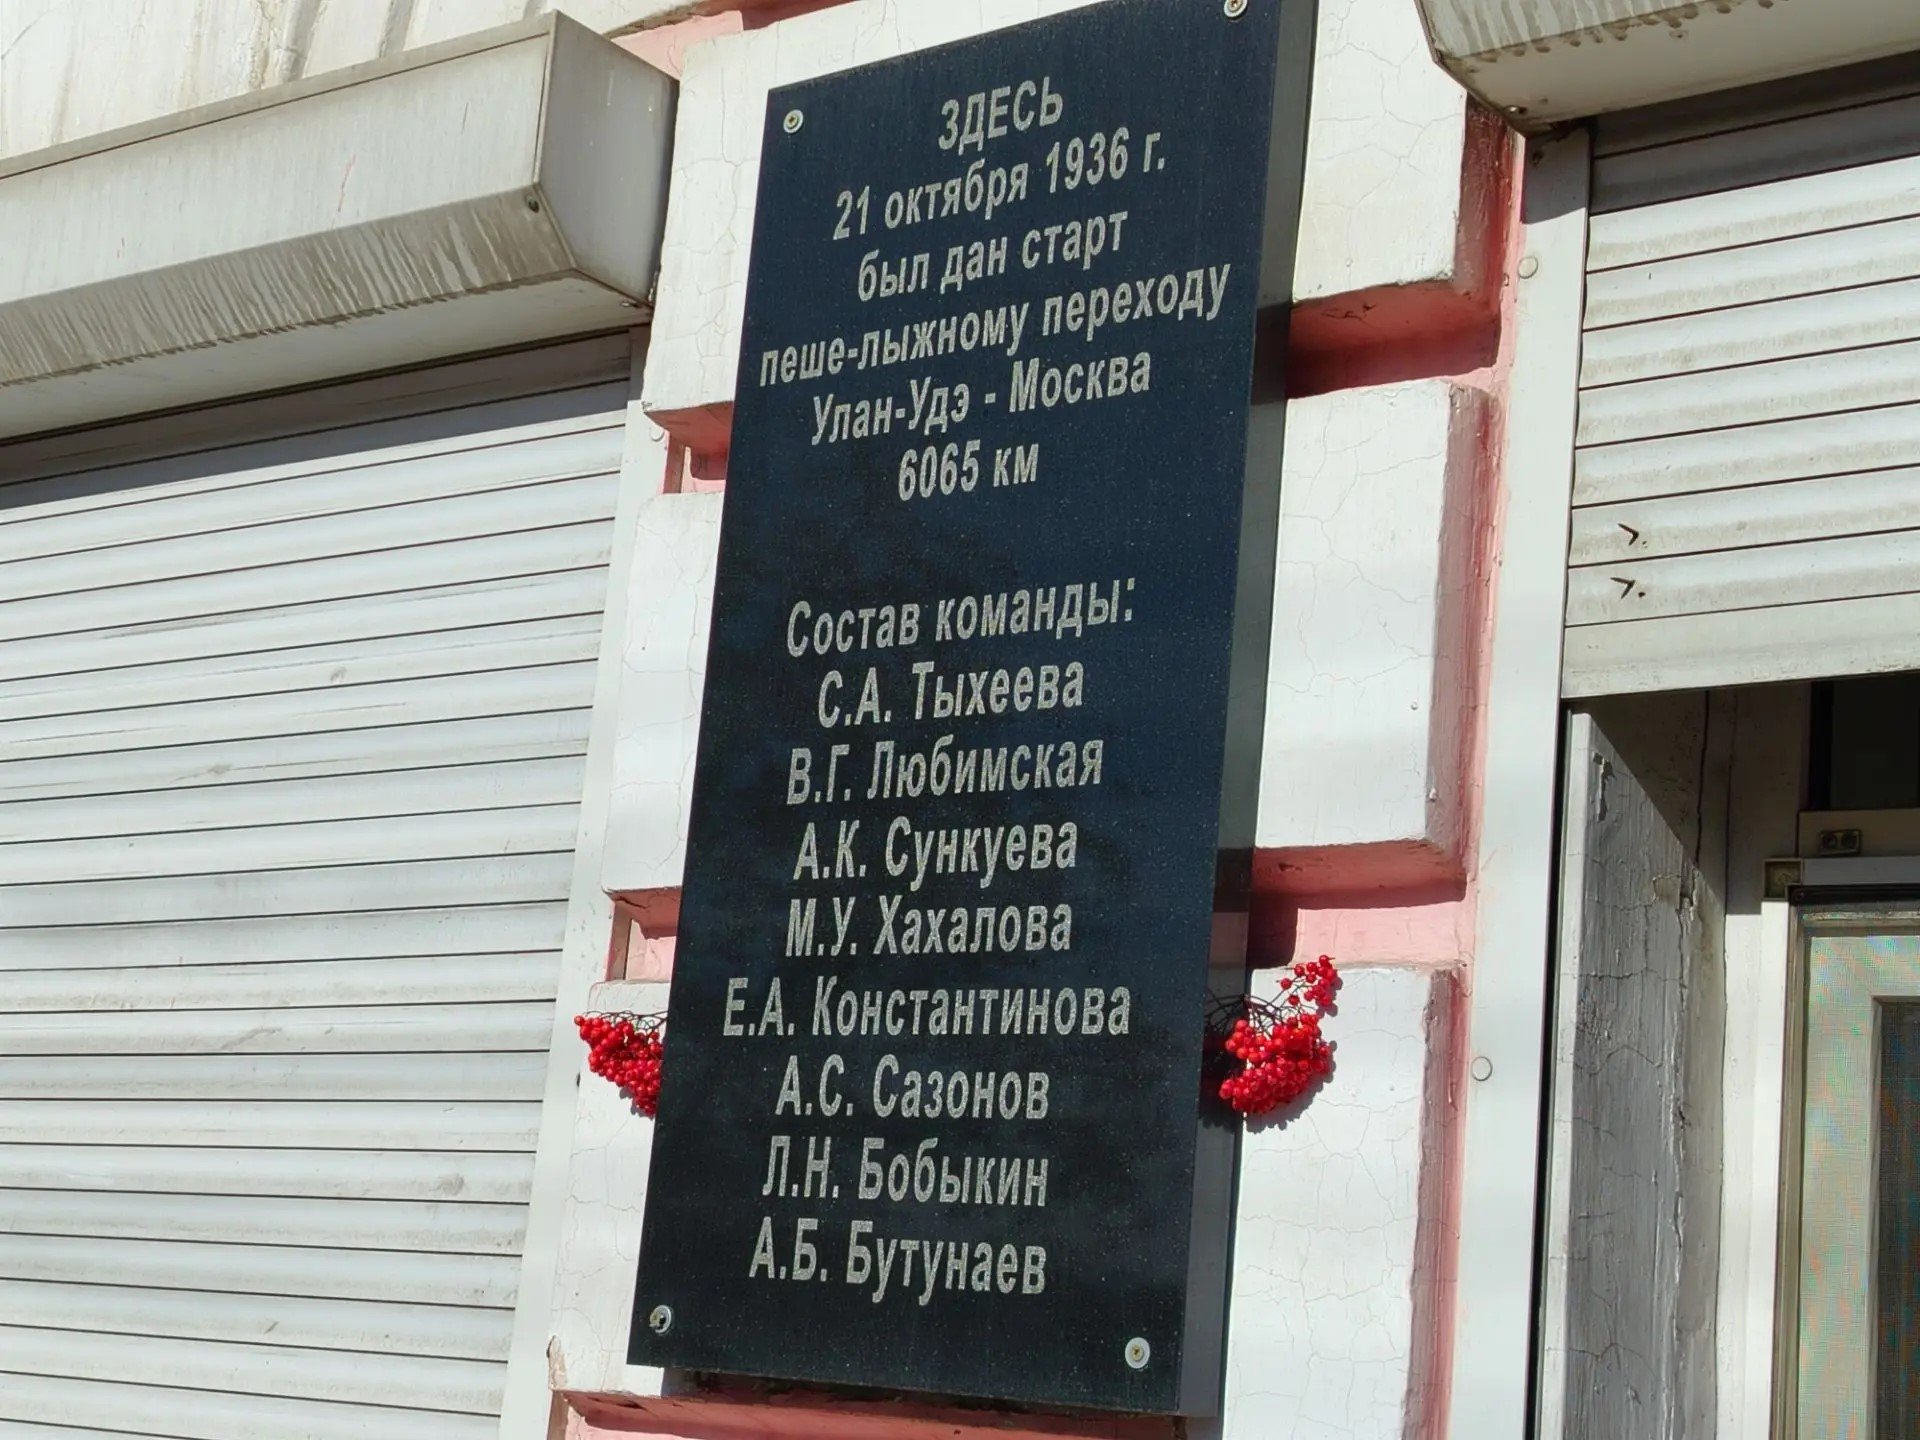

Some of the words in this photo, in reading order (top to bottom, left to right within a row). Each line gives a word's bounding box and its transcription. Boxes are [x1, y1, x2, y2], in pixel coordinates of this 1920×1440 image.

[938, 76, 1064, 156] ЗДЕСЬ
[832, 185, 870, 241] 21
[884, 157, 1029, 229] октября
[1045, 126, 1130, 194] 1936
[1142, 131, 1165, 173] г.
[857, 248, 930, 302] был
[939, 236, 1008, 295] дан
[1021, 210, 1129, 271] старт
[759, 301, 1030, 387] пеше-лыжному
[1042, 263, 1231, 342] переходу
[811, 375, 970, 446] Улан-Удэ
[1008, 351, 1151, 413] Москва
[898, 439, 981, 502] 6065
[992, 443, 1040, 488] км
[786, 600, 921, 658] Состав
[935, 577, 1136, 642] команды:
[818, 666, 892, 729] С.А.
[911, 660, 1084, 720] Тыхеева
[786, 743, 851, 805] В.Г.
[866, 733, 1104, 800] Любимская
[792, 819, 867, 881] А.К.
[885, 815, 1078, 892] Сункуева
[785, 896, 857, 957] М.У.
[872, 894, 1072, 955] Хахалова
[722, 977, 795, 1037] Е.А.
[812, 975, 1131, 1037] Константинова
[774, 1053, 854, 1117] А.С.
[872, 1053, 1050, 1120] Сазонов
[762, 1135, 839, 1199] Л.Н.
[858, 1137, 1049, 1207] Бобыкин
[748, 1216, 828, 1282] А.Б.
[846, 1219, 1047, 1306] Бутунаев
